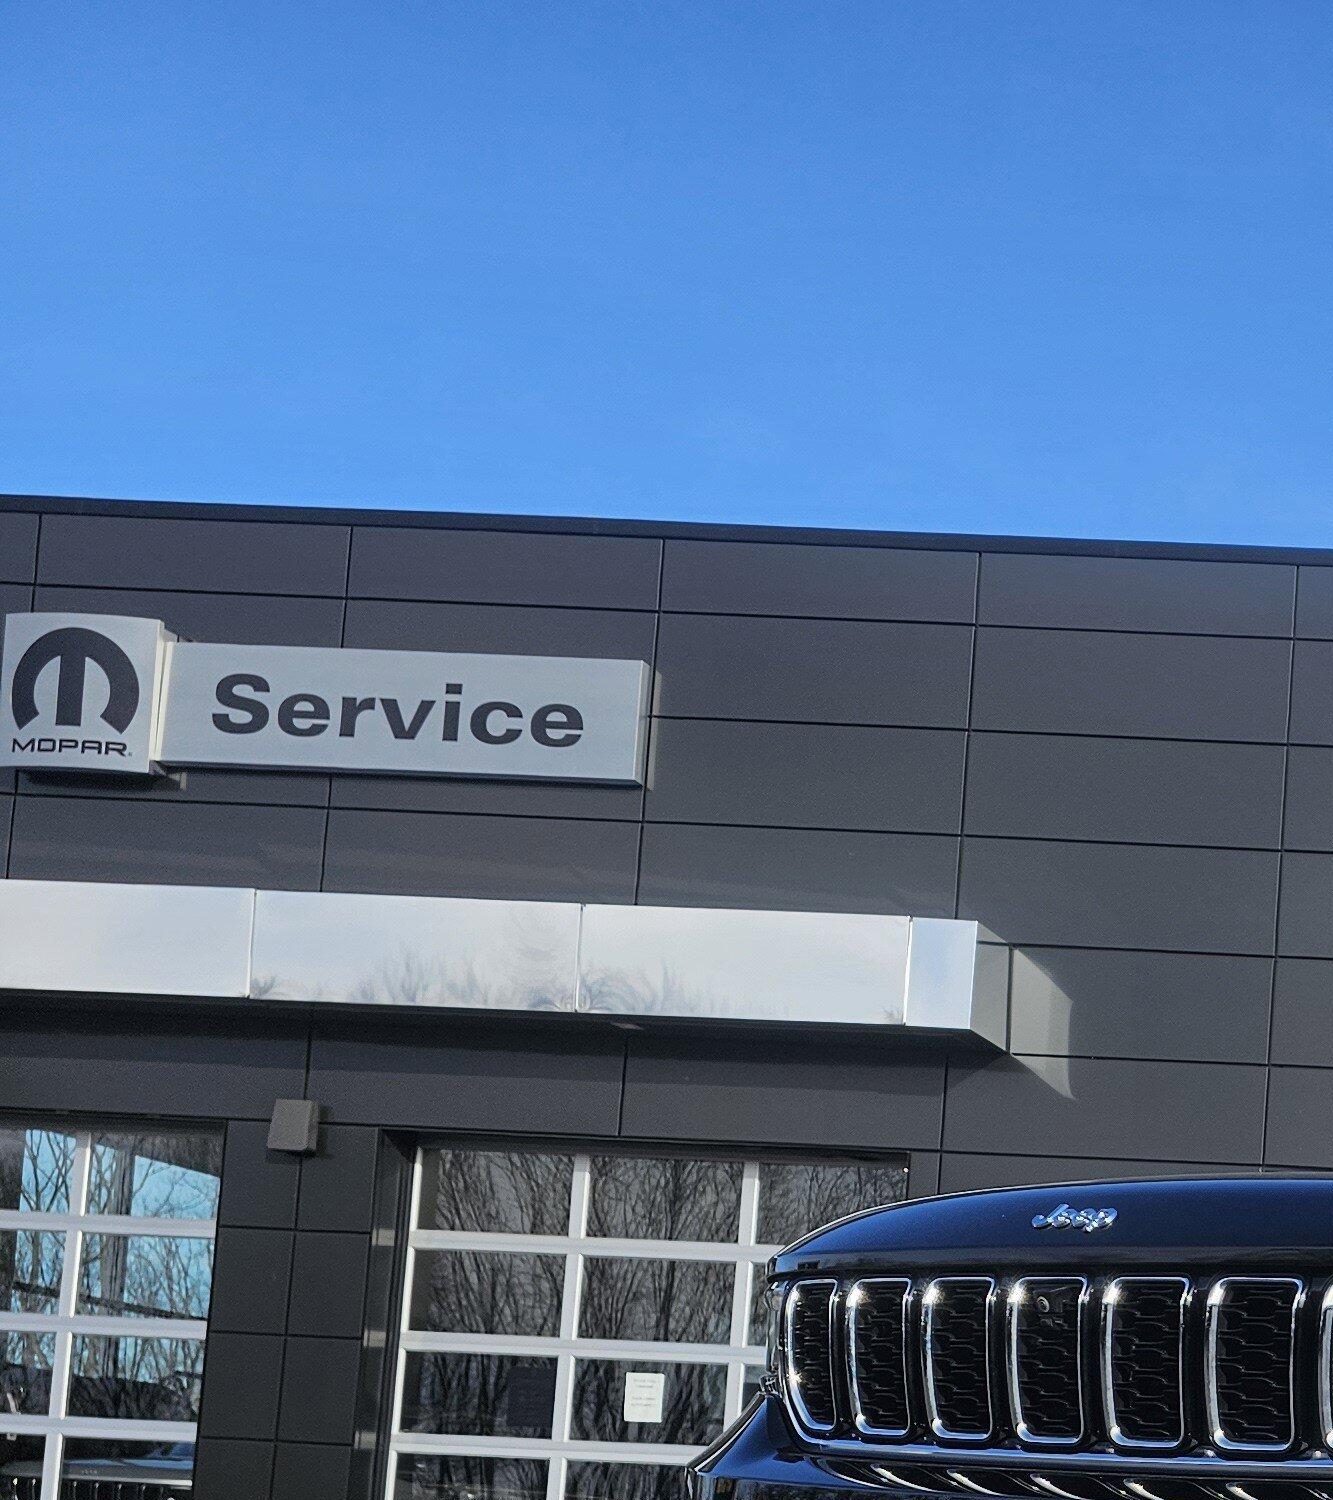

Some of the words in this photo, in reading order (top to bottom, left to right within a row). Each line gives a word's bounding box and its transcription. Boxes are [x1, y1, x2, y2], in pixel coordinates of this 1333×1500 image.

[211, 673, 586, 748] Service
[12, 737, 128, 757] MOPAR
[1031, 1203, 1118, 1232] Jeep
